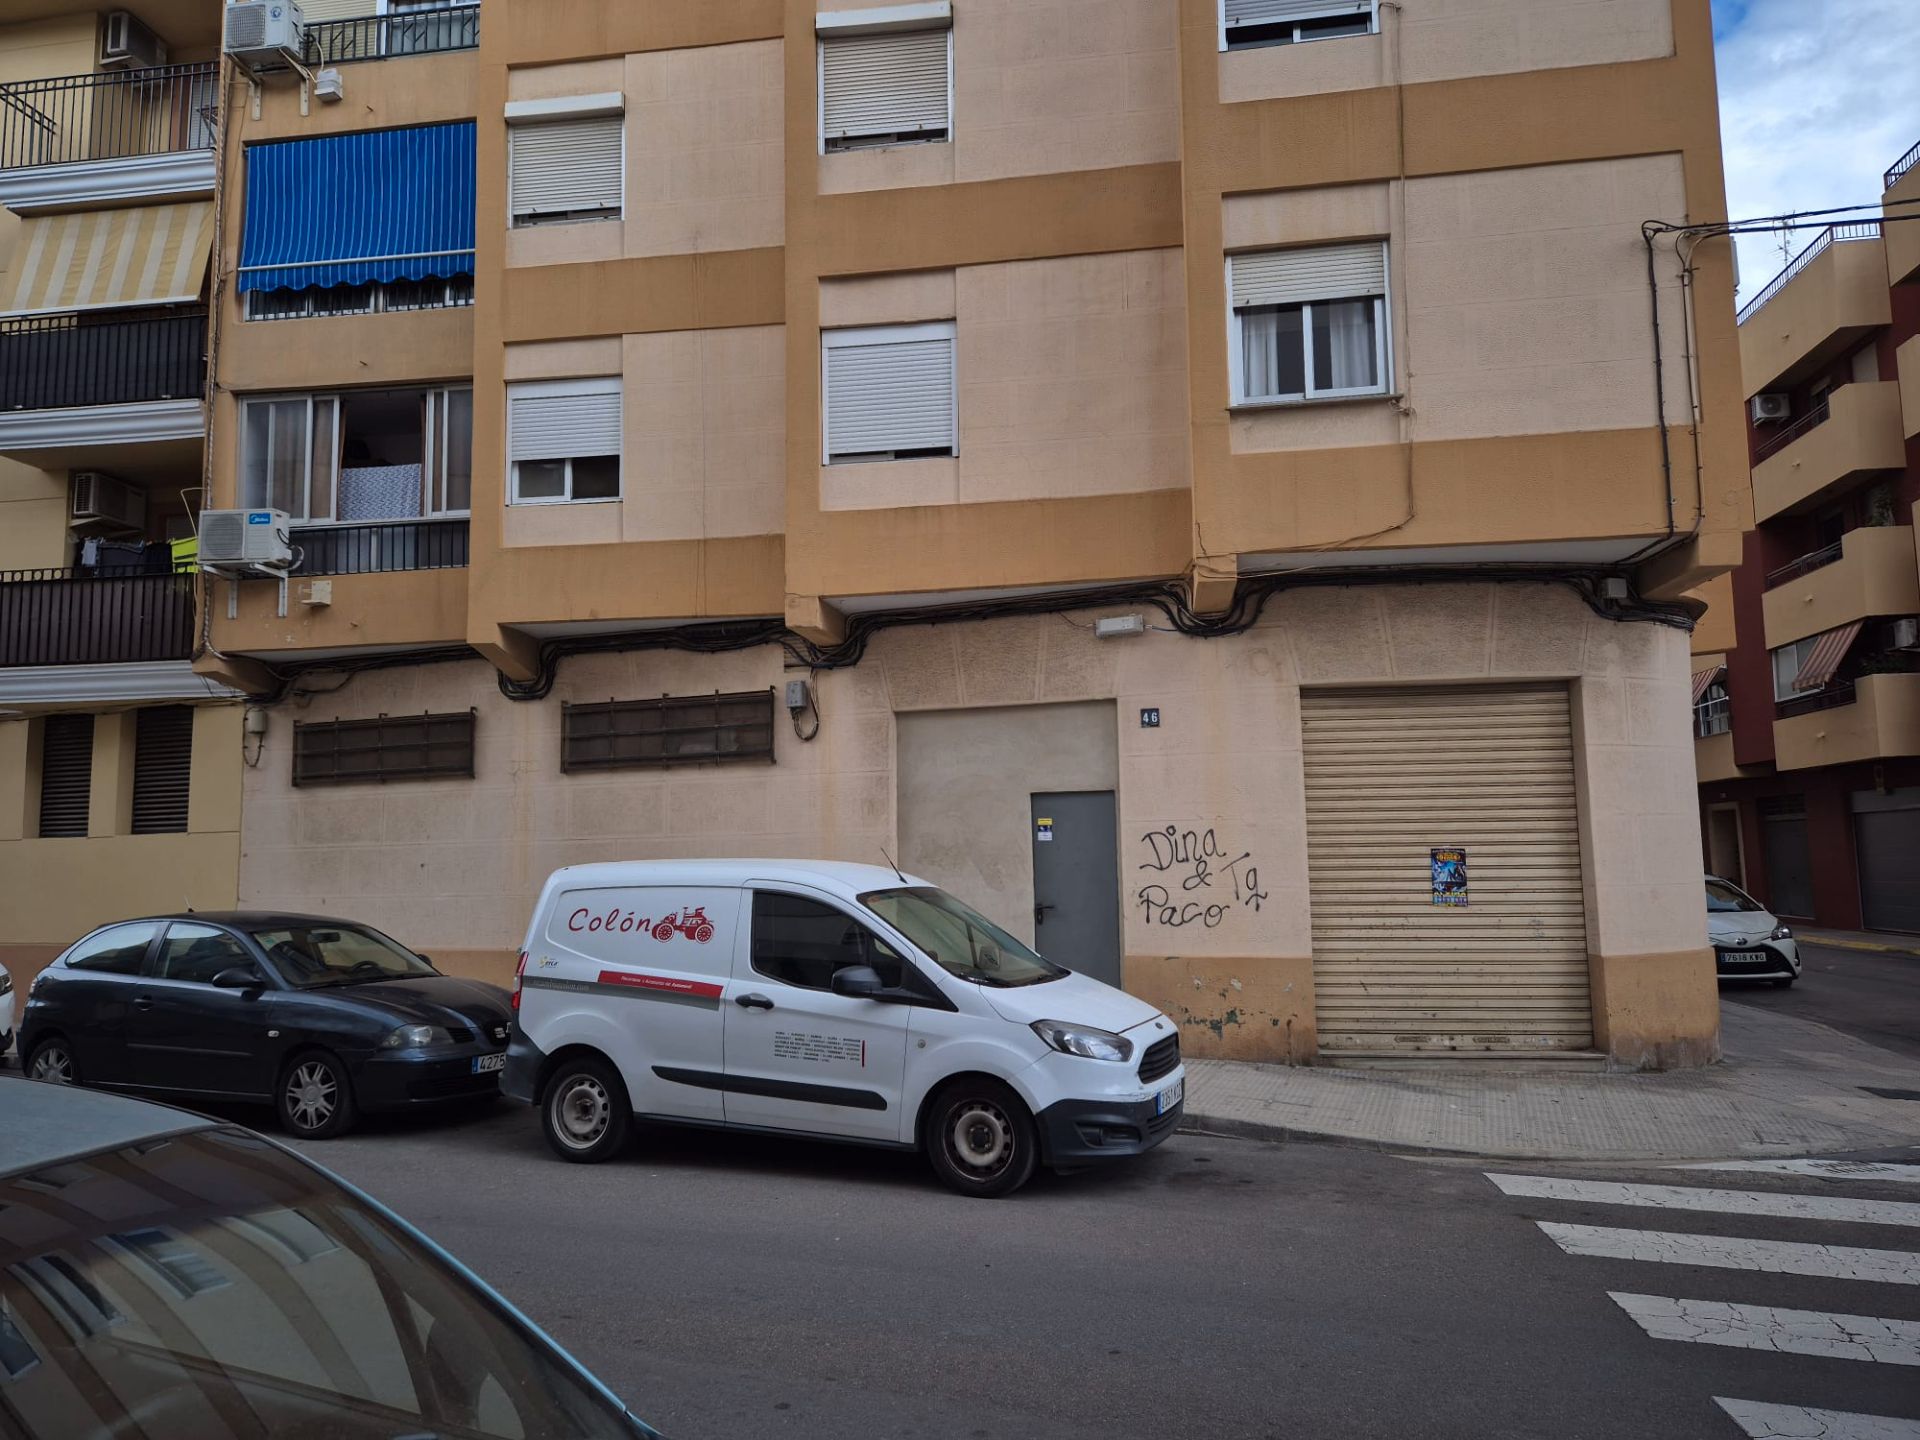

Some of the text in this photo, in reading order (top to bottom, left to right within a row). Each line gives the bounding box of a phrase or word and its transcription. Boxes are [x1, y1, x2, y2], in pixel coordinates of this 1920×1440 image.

[1142, 712, 1158, 723] 46
[1139, 825, 1227, 870] Dina
[1182, 860, 1213, 890] &
[568, 908, 651, 932] Colón
[1138, 885, 1230, 928] Paco
[480, 1053, 505, 1070] 4275
